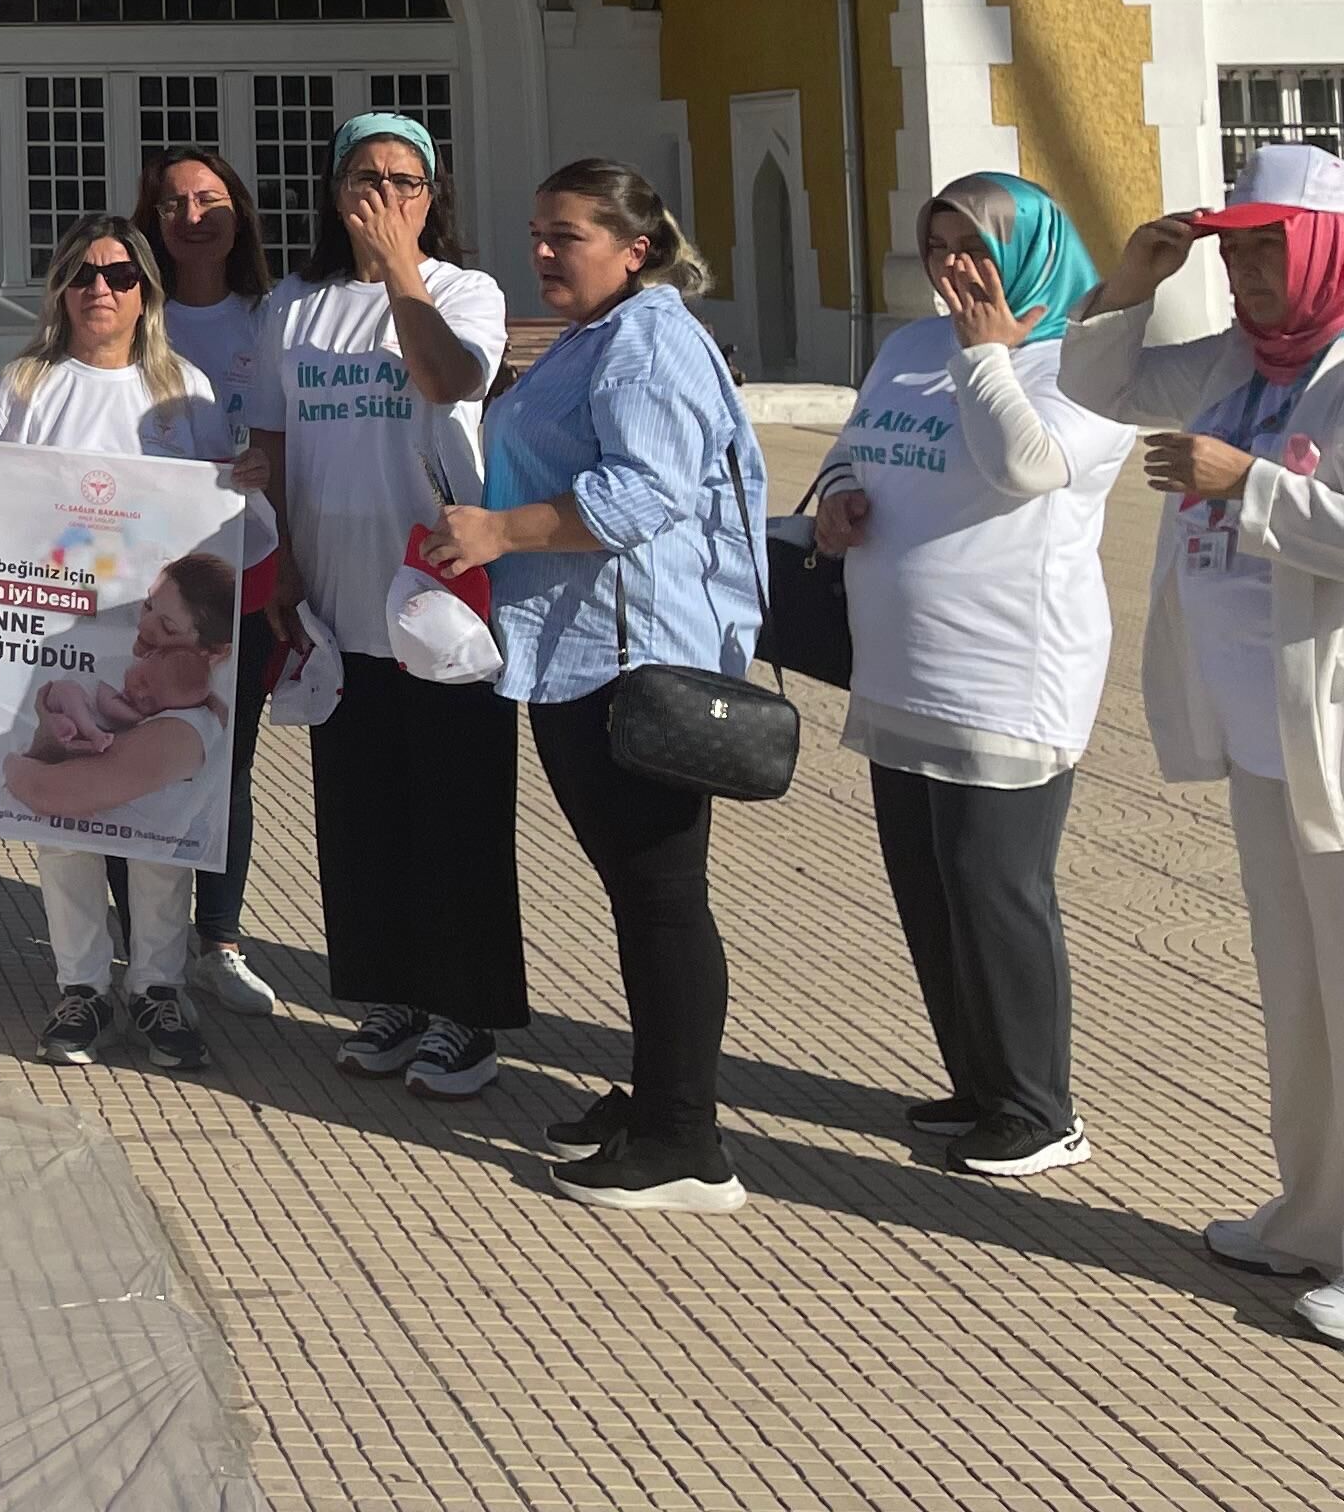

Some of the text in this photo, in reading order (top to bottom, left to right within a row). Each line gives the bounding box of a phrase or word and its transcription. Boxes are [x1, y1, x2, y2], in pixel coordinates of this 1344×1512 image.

[297, 361, 410, 392] İlk Altı Ay
[355, 395, 412, 420] Sütü
[873, 409, 917, 432] Altı
[917, 415, 954, 442] Ay
[849, 443, 947, 473] nne Sütü
[64, 567, 95, 585] için
[8, 584, 33, 605] iyi
[36, 587, 90, 610] besin
